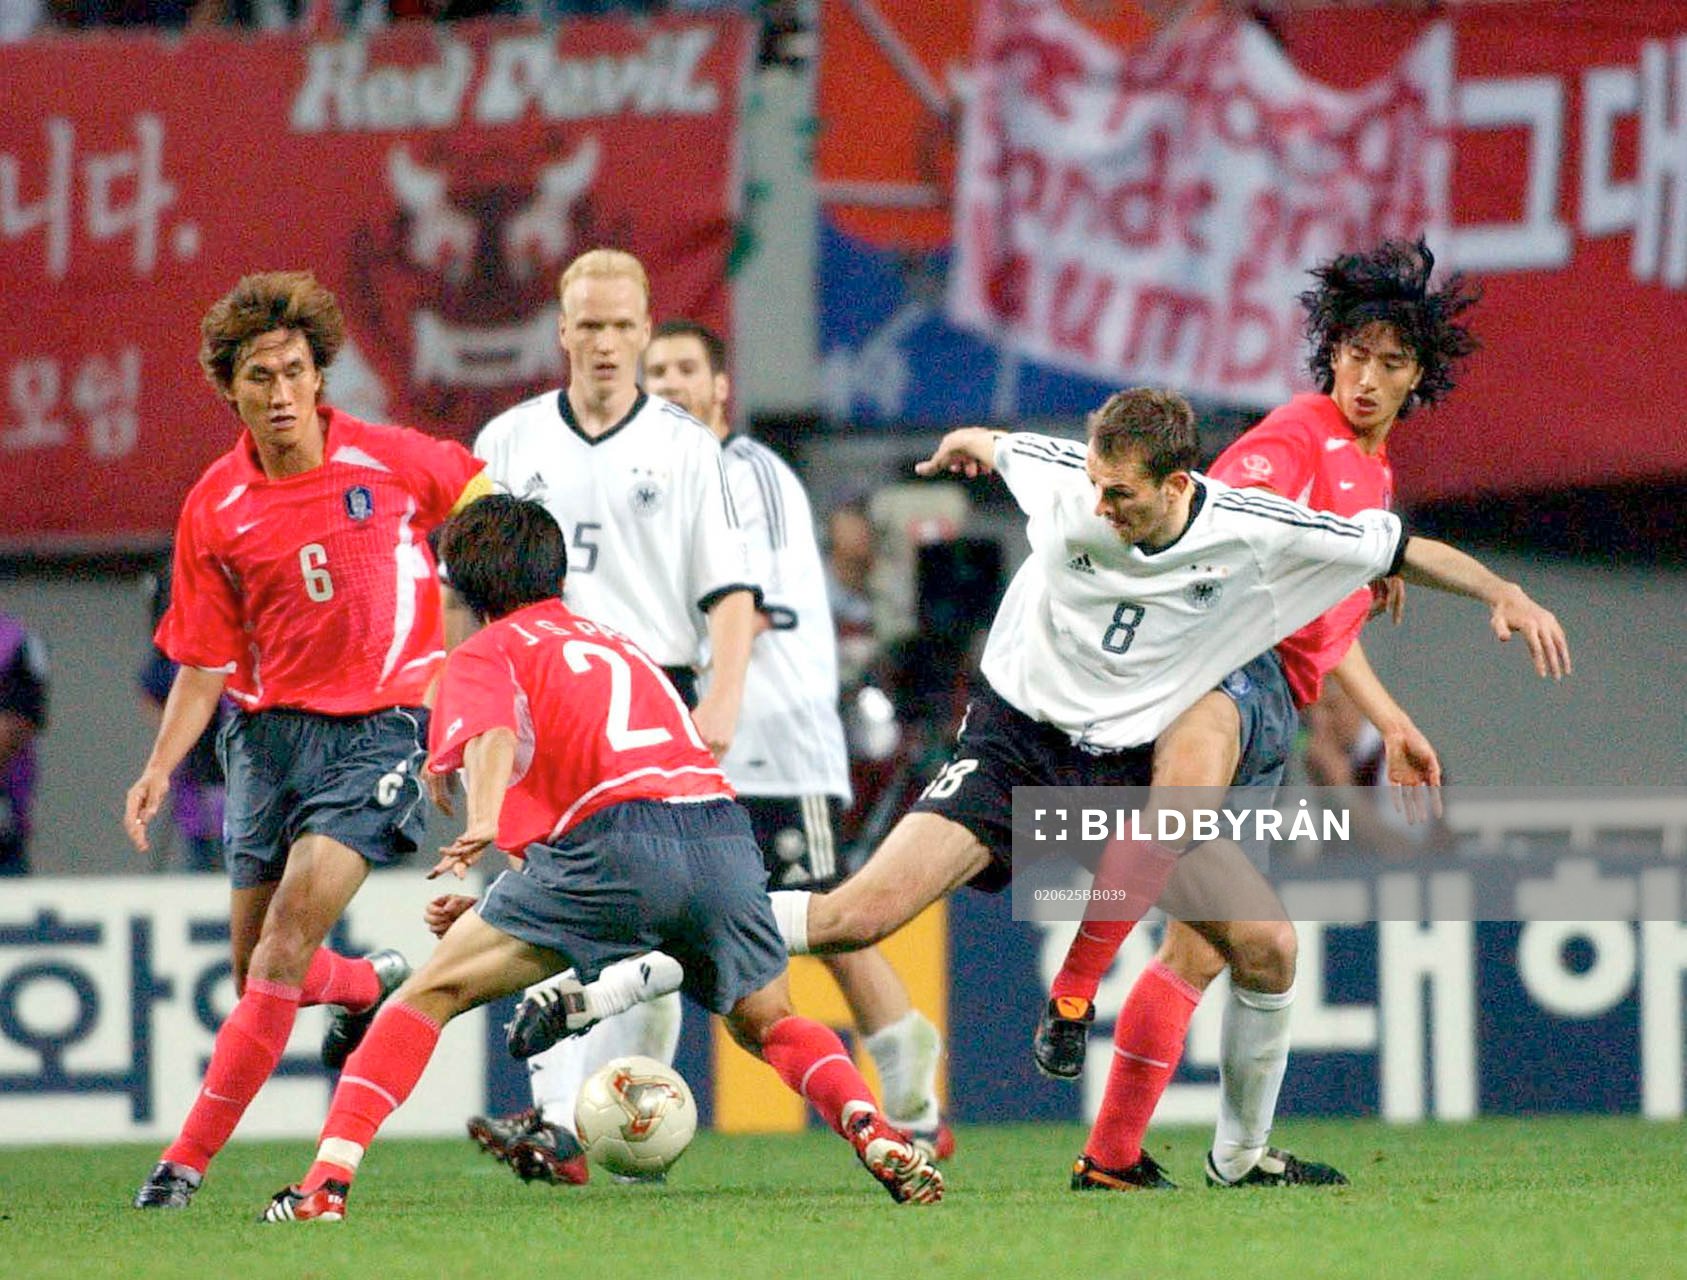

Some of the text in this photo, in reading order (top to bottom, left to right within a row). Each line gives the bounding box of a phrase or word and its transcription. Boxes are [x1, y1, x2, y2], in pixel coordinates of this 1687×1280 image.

[299, 542, 335, 603] 6
[569, 521, 602, 574] 5
[1102, 600, 1146, 655] 8
[562, 639, 708, 753] 21
